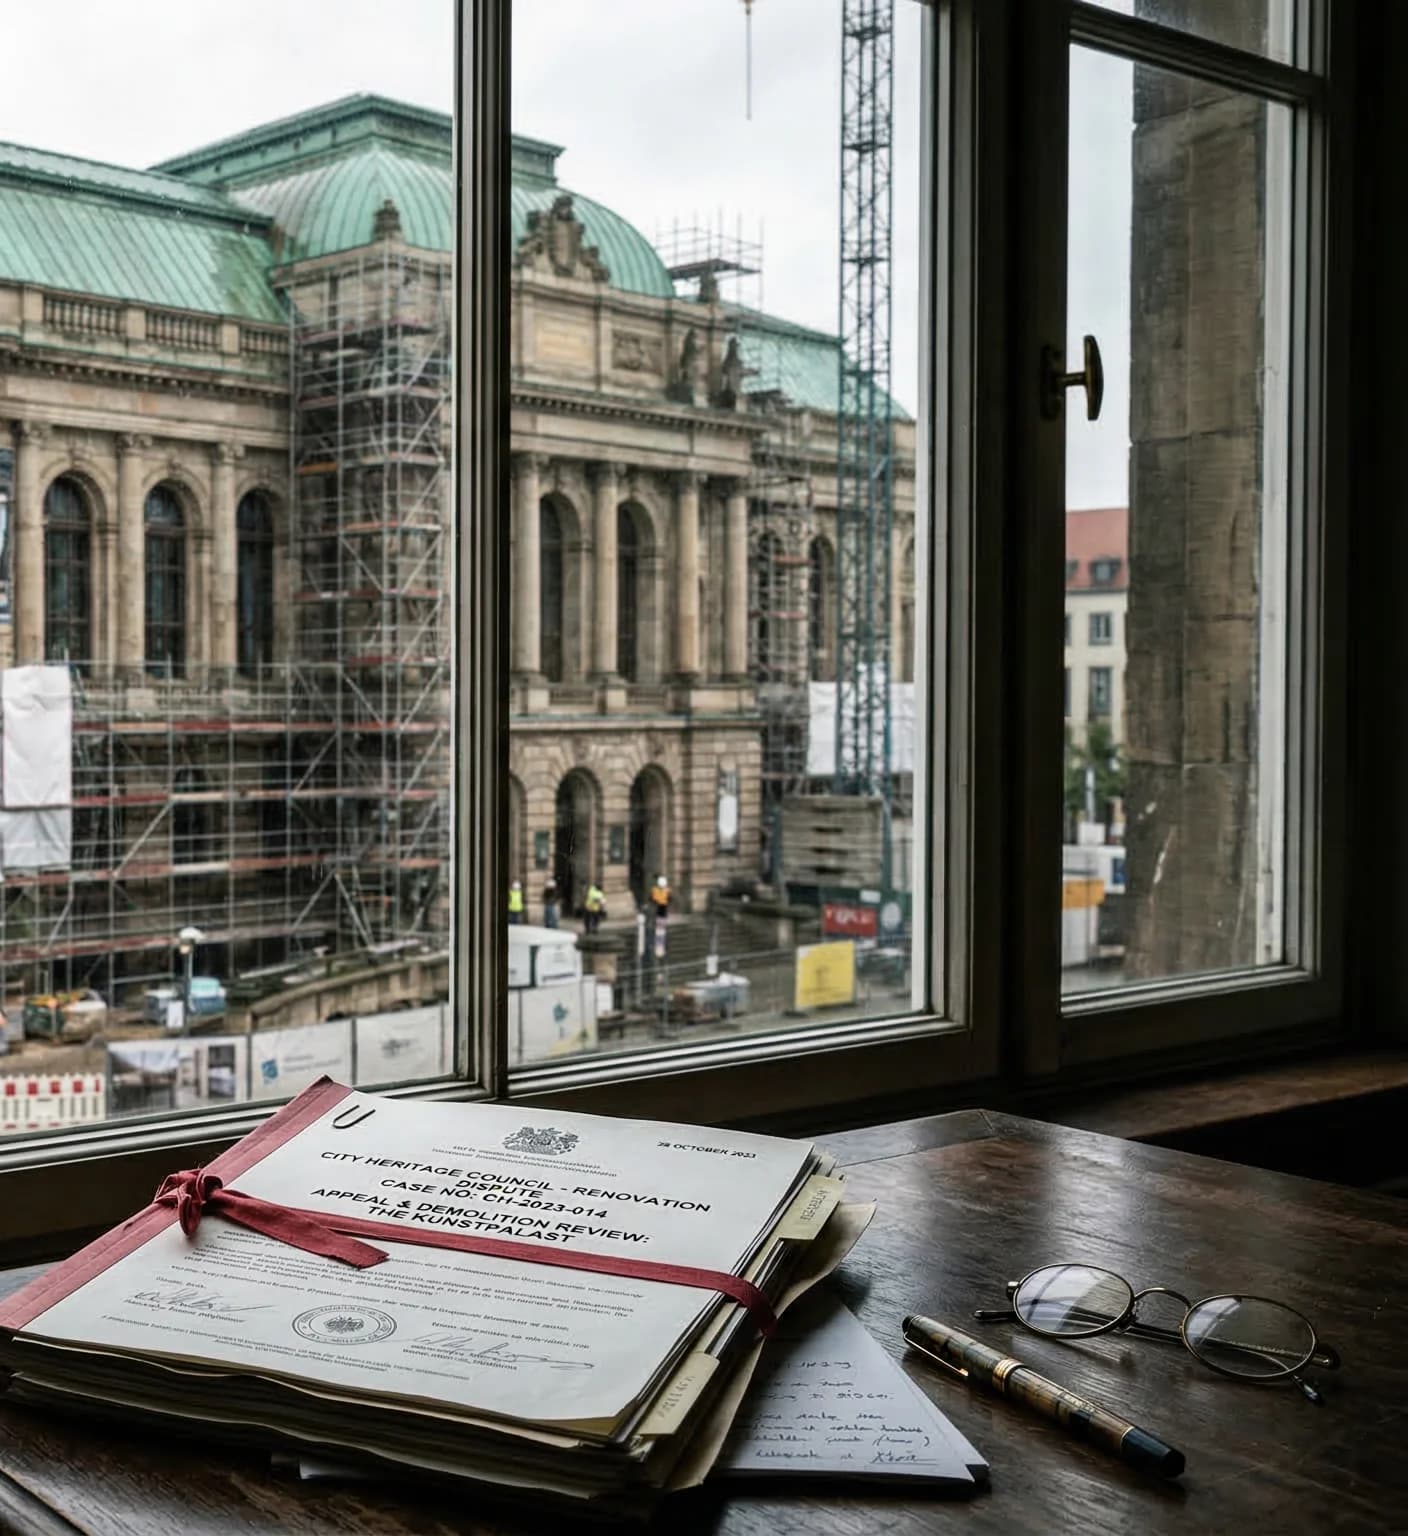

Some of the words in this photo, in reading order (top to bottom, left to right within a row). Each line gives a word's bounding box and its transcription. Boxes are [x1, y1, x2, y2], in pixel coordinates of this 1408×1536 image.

[673, 1143, 729, 1155] OCTOBER
[320, 1151, 364, 1165] CITY
[365, 1156, 463, 1178] HERITAGE
[466, 1171, 554, 1191] COUNCIL
[572, 1186, 711, 1212] RENOVATION
[380, 1179, 437, 1194] CASE
[440, 1187, 474, 1200] NO:
[482, 1193, 608, 1219] CH-2023-014
[455, 1180, 543, 1199] DISPUTE
[310, 1188, 393, 1205] APPEAL
[396, 1200, 411, 1209] &
[415, 1202, 550, 1229] DEMOLITION
[555, 1222, 652, 1244] REVIEW:
[368, 1206, 409, 1220] THE
[410, 1213, 577, 1243] KUNSTPALAST
